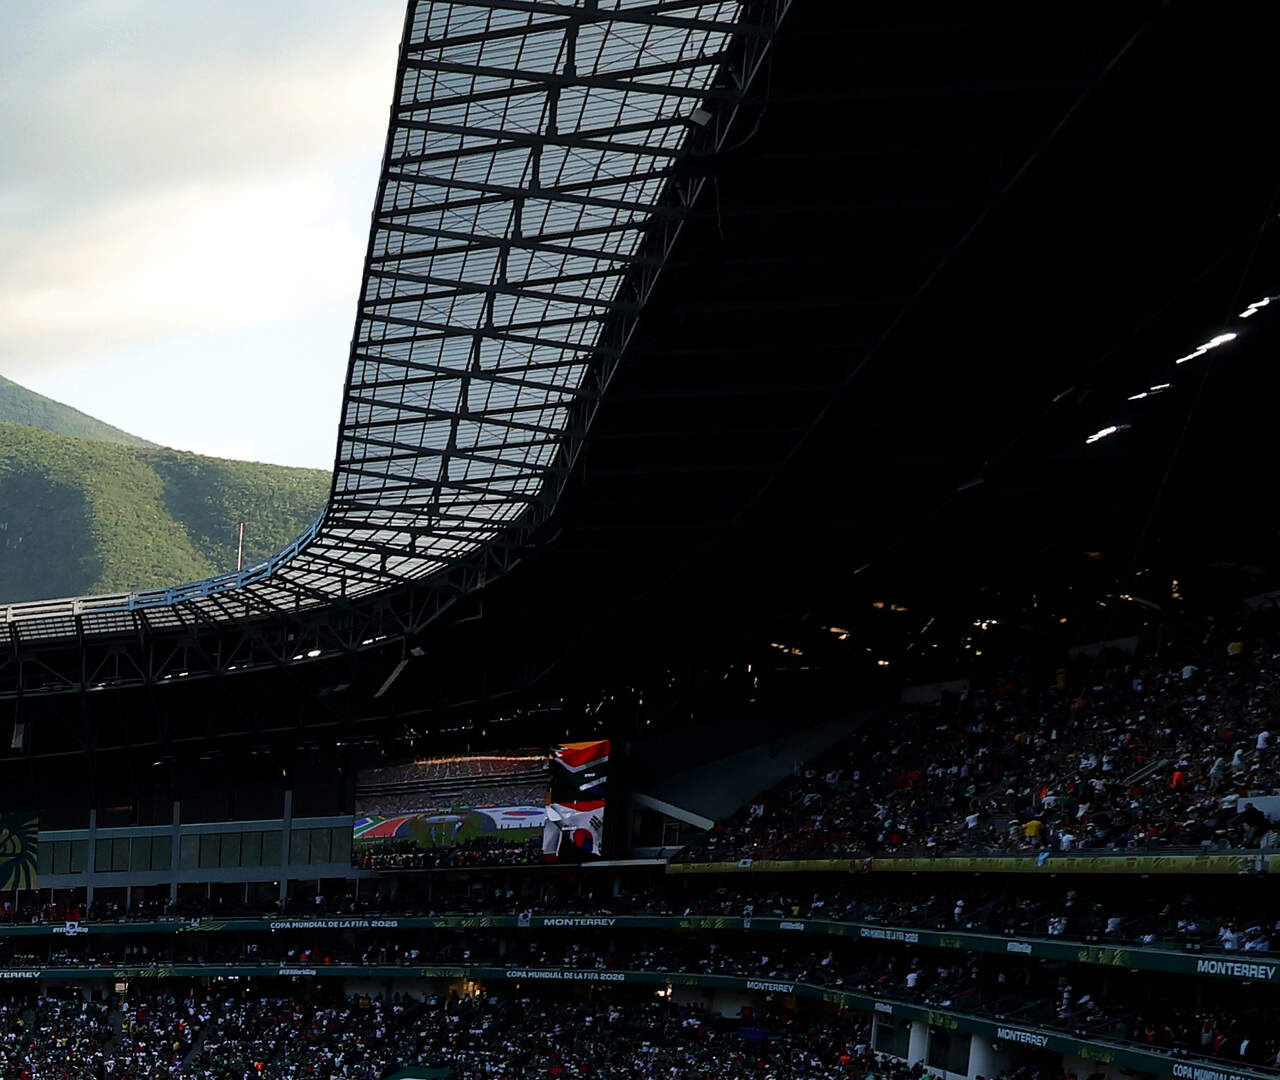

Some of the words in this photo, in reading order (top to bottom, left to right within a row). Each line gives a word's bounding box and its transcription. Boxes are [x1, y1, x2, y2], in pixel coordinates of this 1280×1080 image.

[270, 921, 291, 929] COPA
[351, 920, 369, 928] FIFA
[370, 920, 399, 928] 2026
[544, 918, 616, 926] MONTERREY
[1197, 959, 1276, 980] MONTERREY
[506, 971, 527, 979] COPA
[528, 972, 562, 980] MUNDIAL
[563, 972, 573, 980] DE
[574, 972, 583, 980] LA
[600, 973, 625, 981] 2026
[746, 981, 794, 993] MONTERREY
[997, 1028, 1049, 1048] MONTERREY
[1173, 1063, 1193, 1079] COPA
